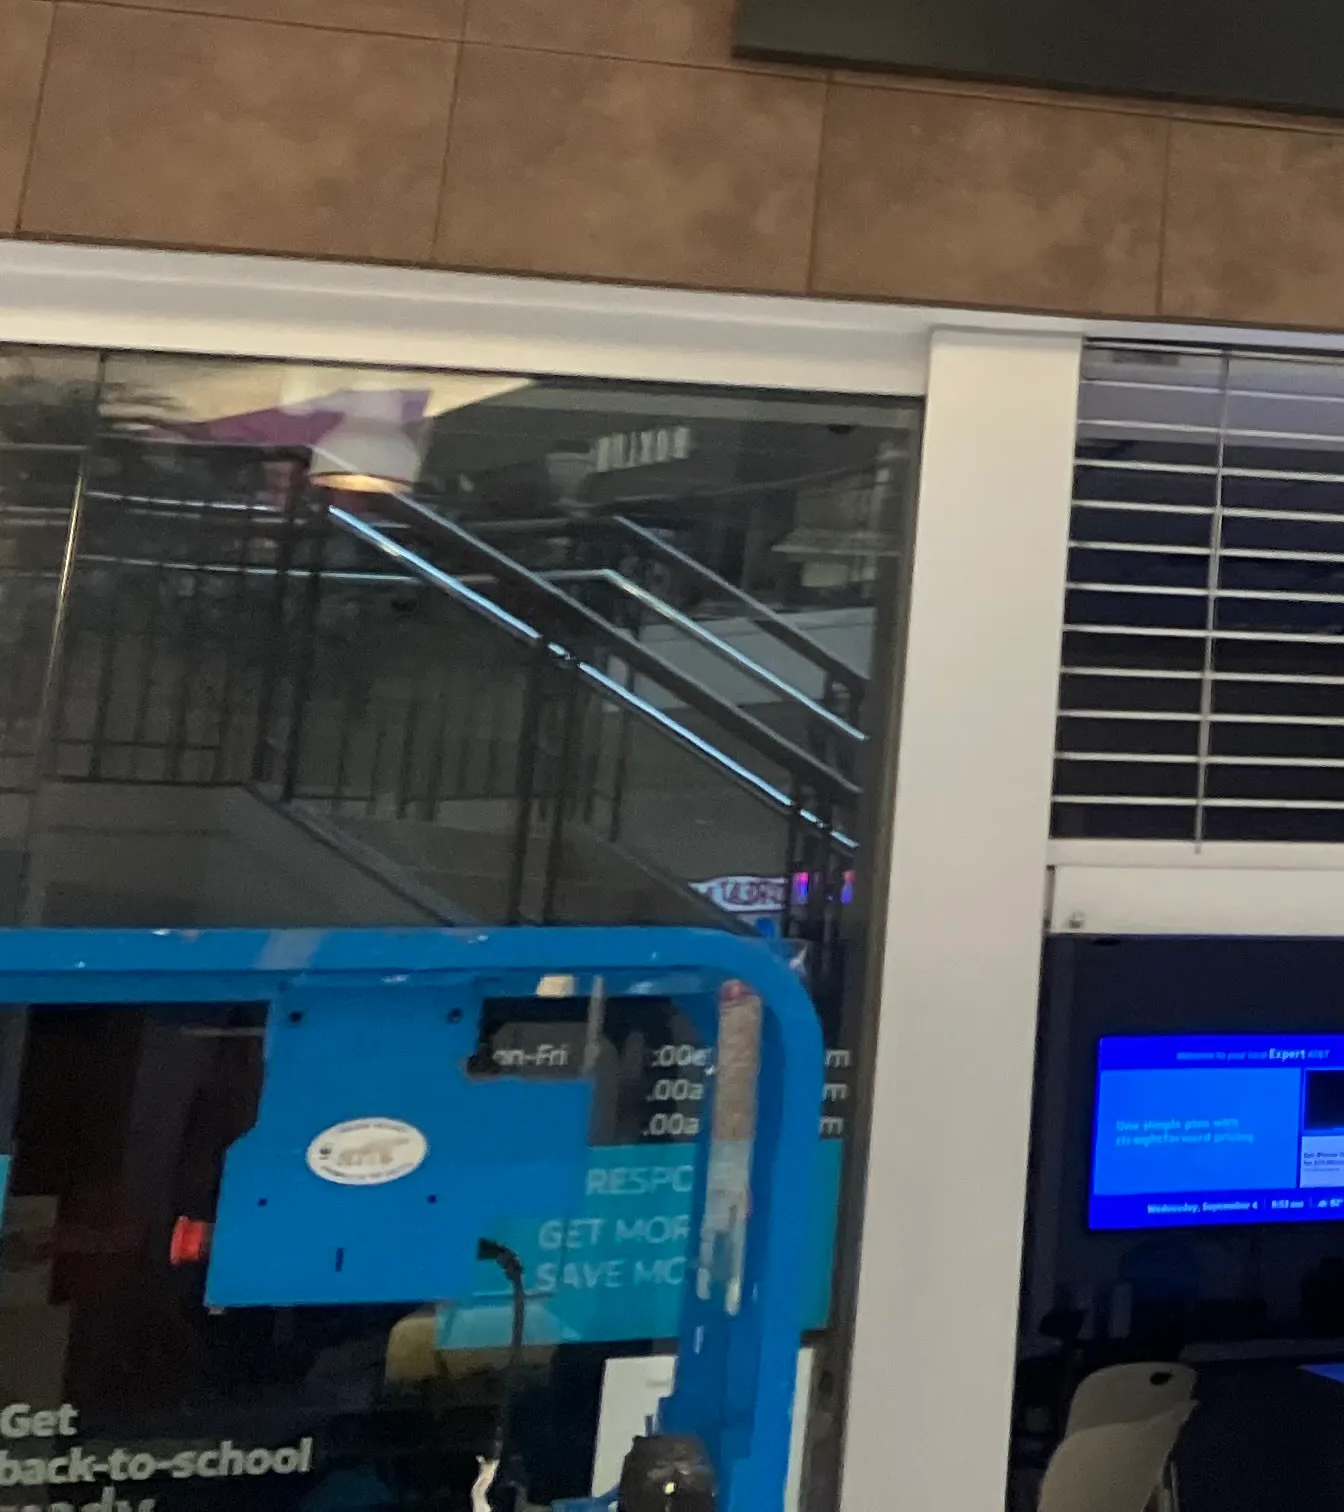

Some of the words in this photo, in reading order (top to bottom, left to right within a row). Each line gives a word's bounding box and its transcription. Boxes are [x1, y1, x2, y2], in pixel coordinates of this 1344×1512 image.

[492, 1044, 569, 1067] on-Fri
[1269, 1048, 1306, 1062] Expert
[586, 1164, 695, 1196] RESPO
[538, 1217, 604, 1251] GET
[615, 1213, 692, 1245] MOR
[535, 1260, 624, 1290] SAVE
[0, 1402, 79, 1437] Get
[0, 1437, 313, 1486] back-to-school
